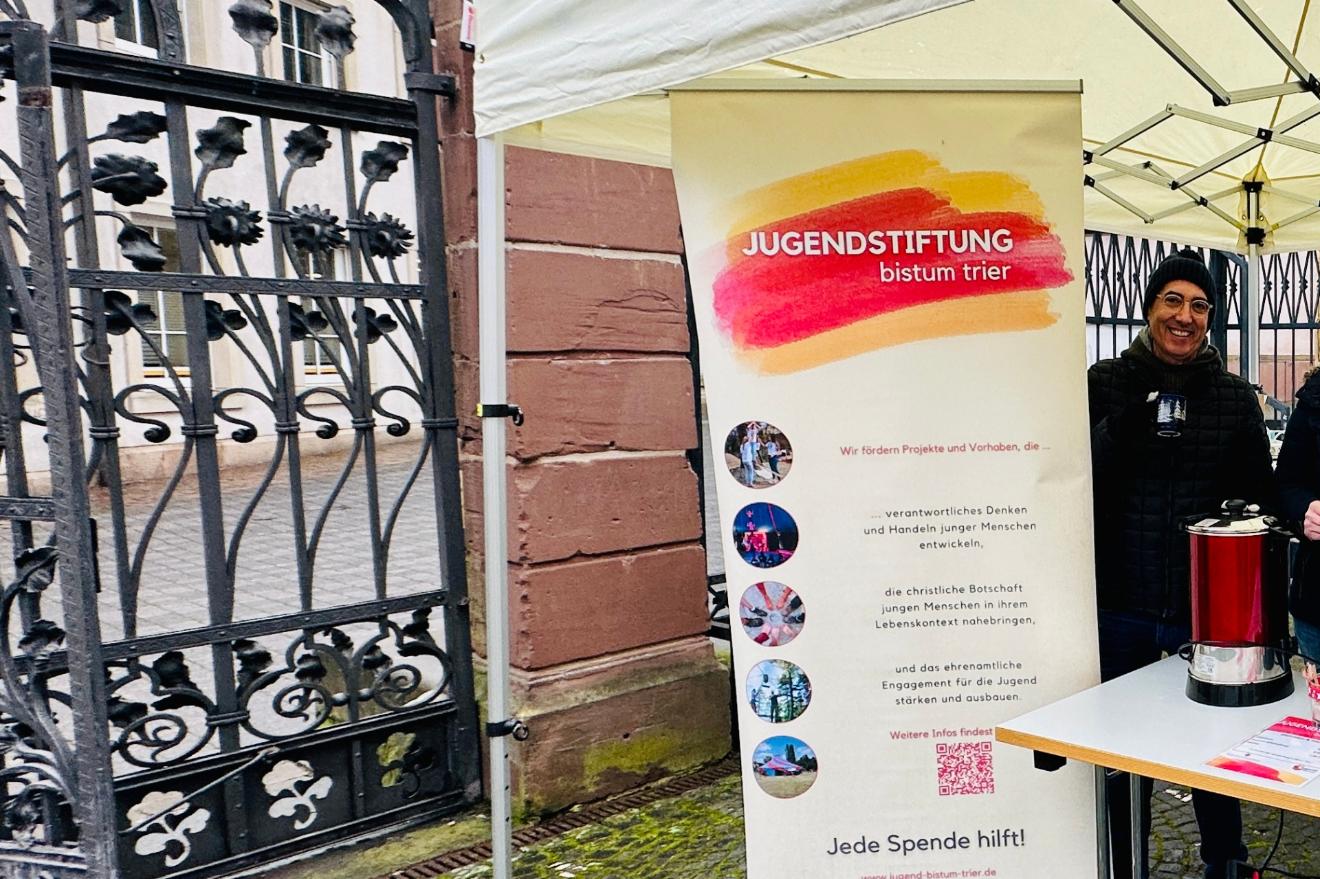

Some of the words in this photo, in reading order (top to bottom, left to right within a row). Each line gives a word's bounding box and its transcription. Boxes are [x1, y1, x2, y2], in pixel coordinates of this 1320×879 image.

[743, 229, 1012, 255] JUGENDSTIFTUNG
[880, 262, 954, 281] bistum
[963, 261, 1010, 280] trier
[839, 446, 859, 456] Wir
[861, 444, 900, 456] fördern
[901, 443, 945, 457] Projekte
[947, 442, 967, 453] und
[968, 441, 1021, 452] Vorhaben,
[1023, 441, 1040, 451] die
[885, 505, 983, 518] verantwortliches
[985, 505, 1028, 515] Denken
[863, 525, 885, 535] und
[888, 523, 937, 535] Handeln
[940, 522, 977, 536] junger
[980, 521, 1037, 531] Menschen
[919, 538, 984, 550] entwickeln,
[884, 587, 903, 597] die
[906, 584, 966, 596] christliche
[968, 583, 1023, 594] Botschaft
[881, 602, 920, 616] jungen
[923, 600, 981, 612] Menschen
[984, 600, 994, 609] in
[997, 599, 1029, 609] ihrem
[875, 617, 959, 629] Lebenskontext
[962, 615, 1036, 627] nahebringen,
[895, 663, 916, 674] und
[919, 663, 940, 673] das
[943, 660, 1022, 672] ehrenamtliche
[881, 679, 952, 692] Engagement
[955, 677, 973, 687] für
[976, 676, 993, 687] die
[996, 675, 1037, 688] Jugend
[895, 695, 938, 706] stärken
[941, 693, 962, 704] und
[889, 730, 930, 740] Weitere
[931, 727, 958, 739] Infos
[959, 727, 994, 737] findest
[827, 836, 880, 855] Jede
[888, 831, 970, 856] Spende
[978, 829, 1024, 848] hilft!
[861, 868, 996, 879] wwwjugend-bistum-trier.de
